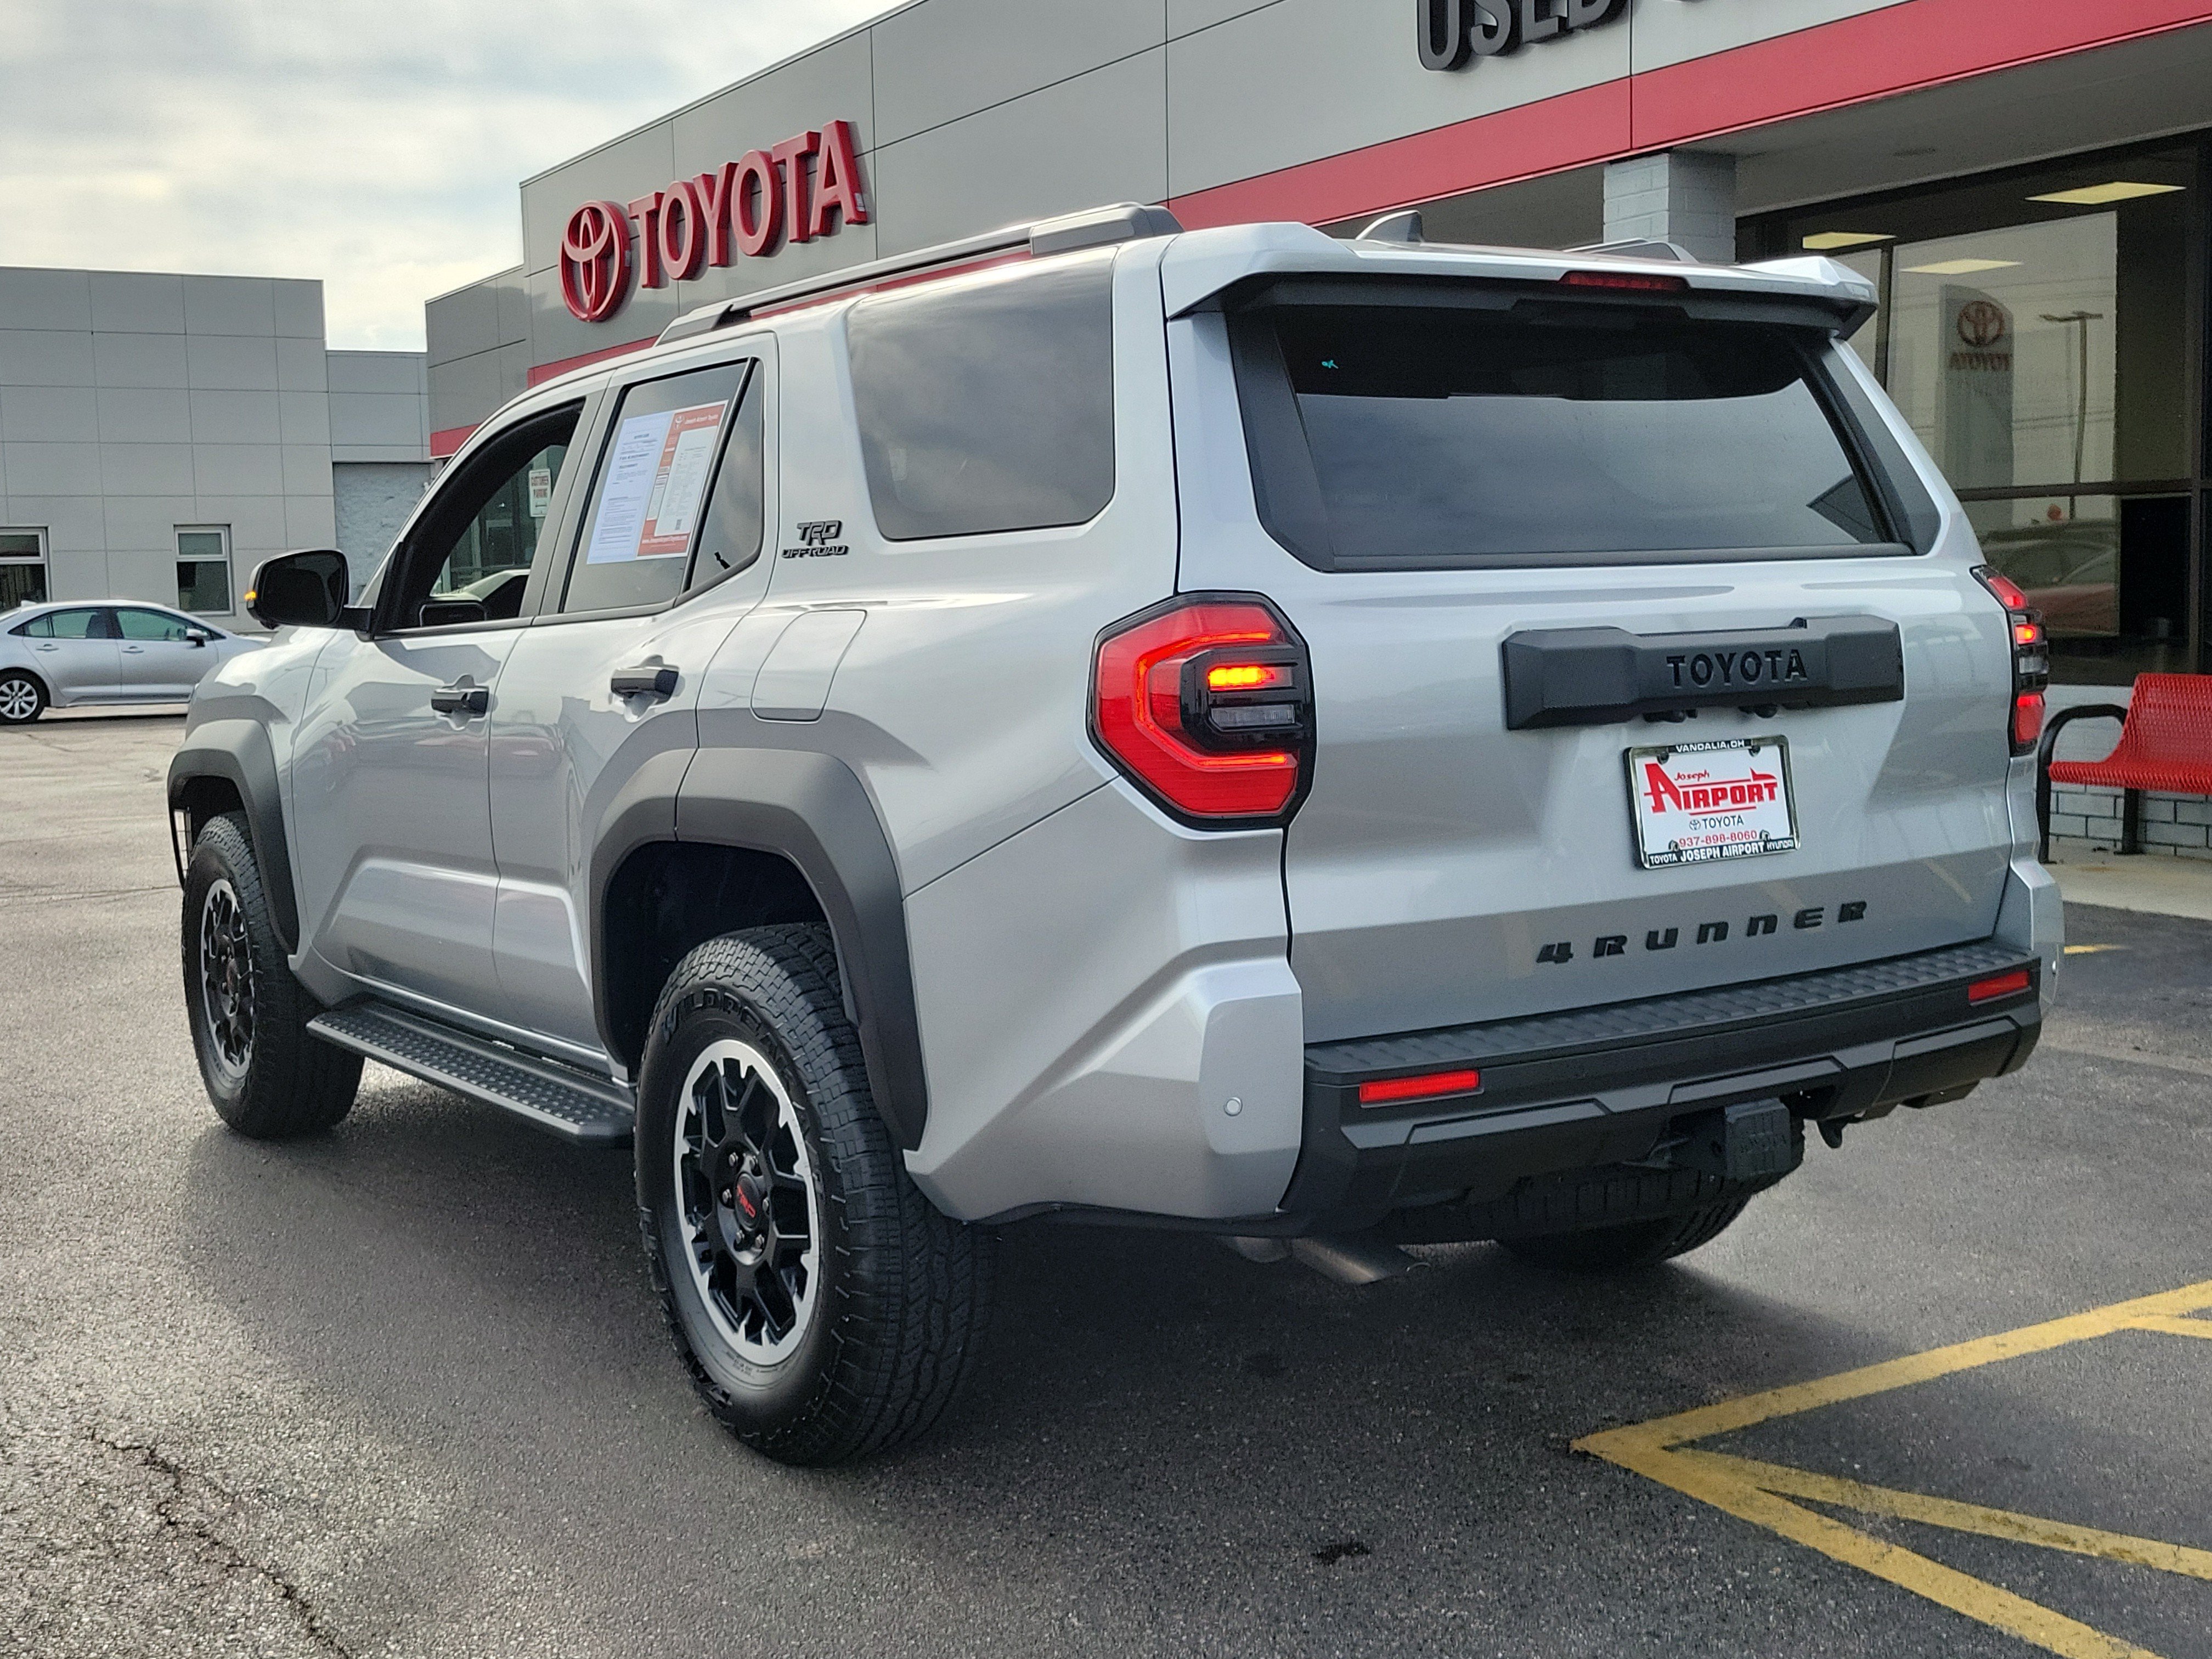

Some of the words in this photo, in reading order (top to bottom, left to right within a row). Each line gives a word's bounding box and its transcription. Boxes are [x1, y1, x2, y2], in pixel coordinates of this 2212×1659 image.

[628, 120, 867, 289] TOYOTA
[797, 520, 842, 546] TRD
[1666, 649, 1808, 689] TOYOTA
[1644, 763, 1778, 814] AIRPORT
[1674, 769, 1710, 782] Joseph
[1702, 815, 1744, 830] TOYOTA
[1679, 830, 1757, 848] 937-898-8060
[1650, 854, 1677, 865] TOYOTA
[1680, 847, 1720, 862] JOSEPH
[1722, 842, 1764, 857] AIRPORT
[1536, 900, 1867, 964] 4RUNNER
